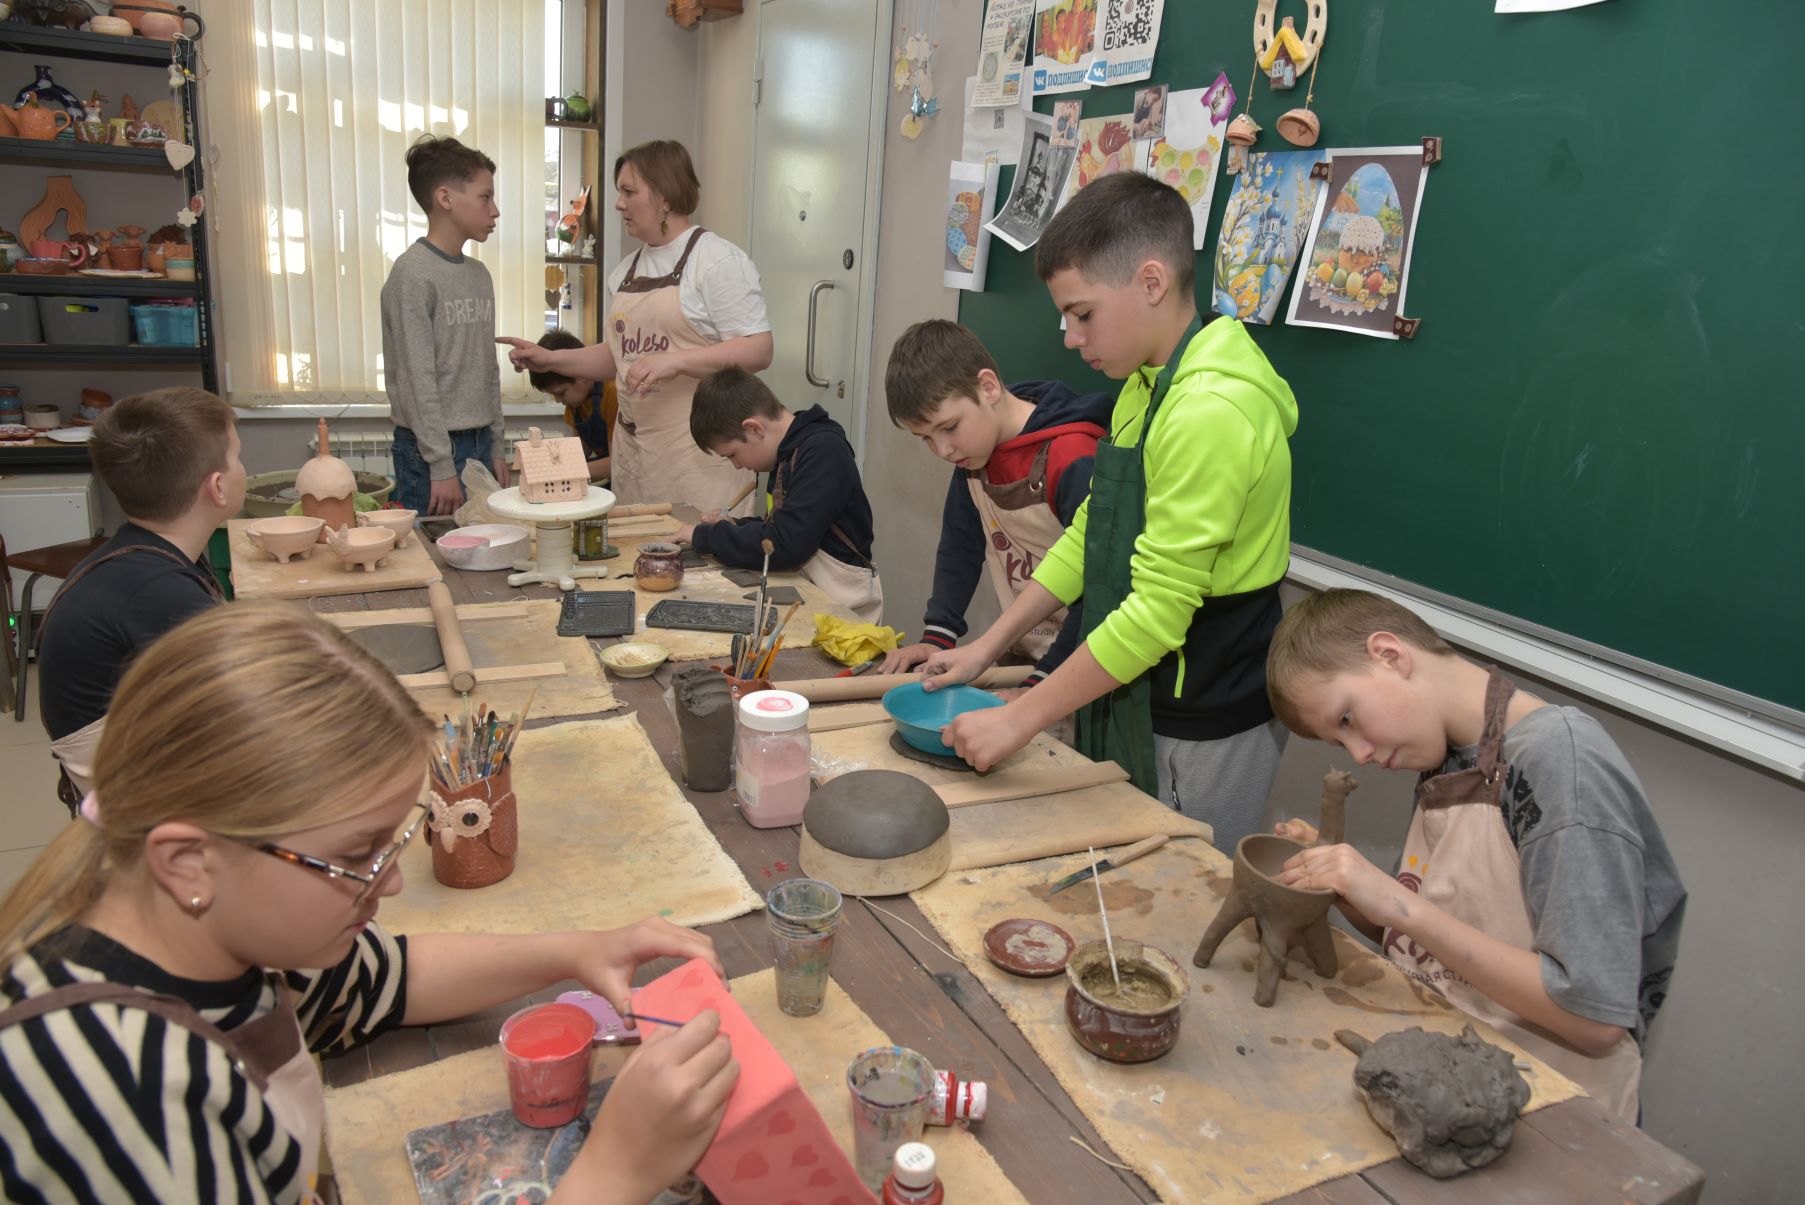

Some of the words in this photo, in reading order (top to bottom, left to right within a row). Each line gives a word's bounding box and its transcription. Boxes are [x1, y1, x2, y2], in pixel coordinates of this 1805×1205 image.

[1047, 69, 1088, 87] ПОДПИШИС
[1107, 57, 1153, 78] ПОДПИШИС
[444, 298, 492, 326] DREAM
[621, 327, 669, 358] koleso
